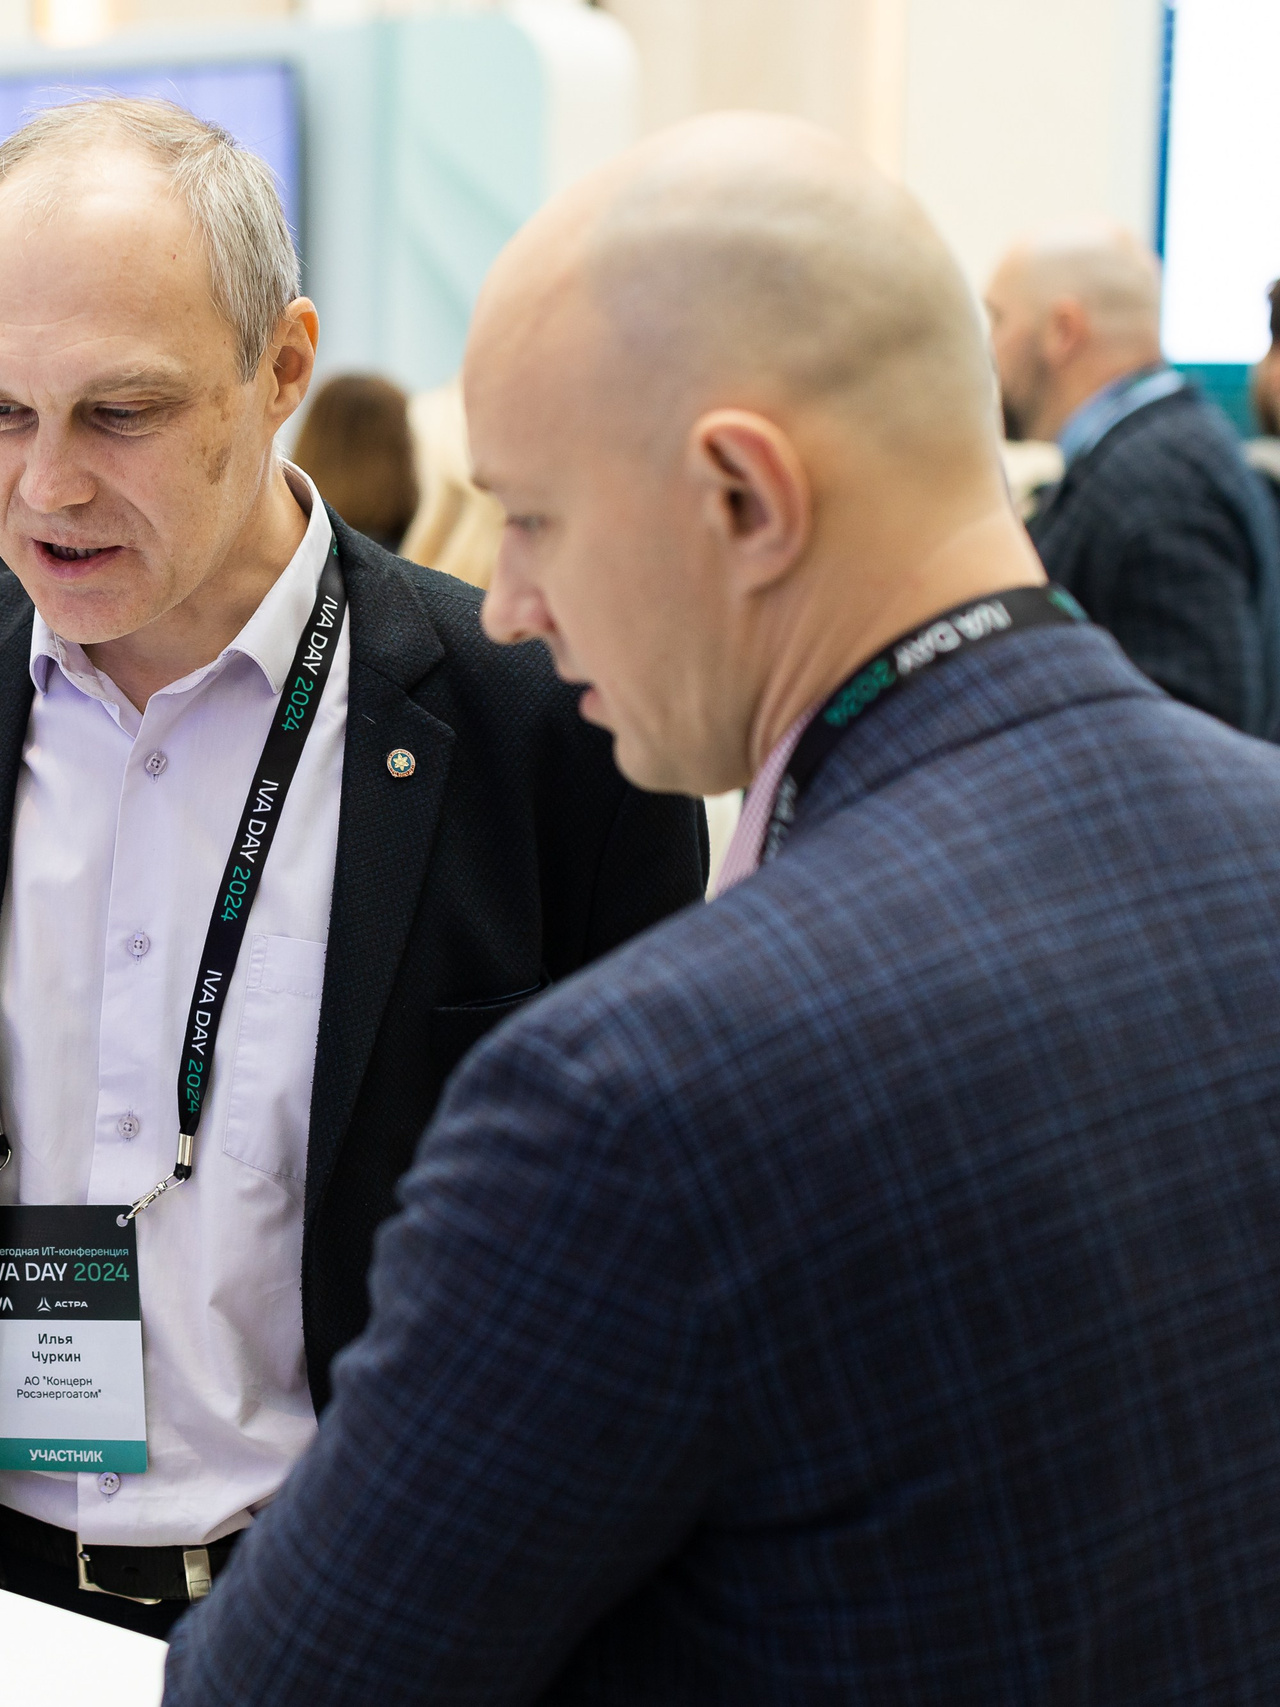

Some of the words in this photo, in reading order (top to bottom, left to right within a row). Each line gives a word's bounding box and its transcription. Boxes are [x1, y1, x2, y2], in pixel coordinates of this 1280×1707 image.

[316, 595, 339, 630] IVA
[302, 631, 329, 676] DAY
[281, 676, 314, 732] 2024
[253, 779, 280, 813] IVA
[239, 818, 267, 864] DAY
[220, 865, 251, 922] 2024
[198, 969, 223, 1005] IVA
[191, 1010, 212, 1056] DAY
[186, 1058, 204, 1114] 2024
[41, 1246, 129, 1257] ИТ-конференция
[25, 1262, 68, 1281] DAY
[73, 1263, 130, 1282] 2024
[54, 1300, 89, 1309] АСТРА
[37, 1333, 73, 1345] Илья
[31, 1351, 81, 1365] Чуркин
[16, 1389, 102, 1400] Росэнергоатом"
[24, 1376, 40, 1386] АО
[43, 1376, 93, 1388] "Концерн
[29, 1449, 104, 1463] УЧАСТНИК
